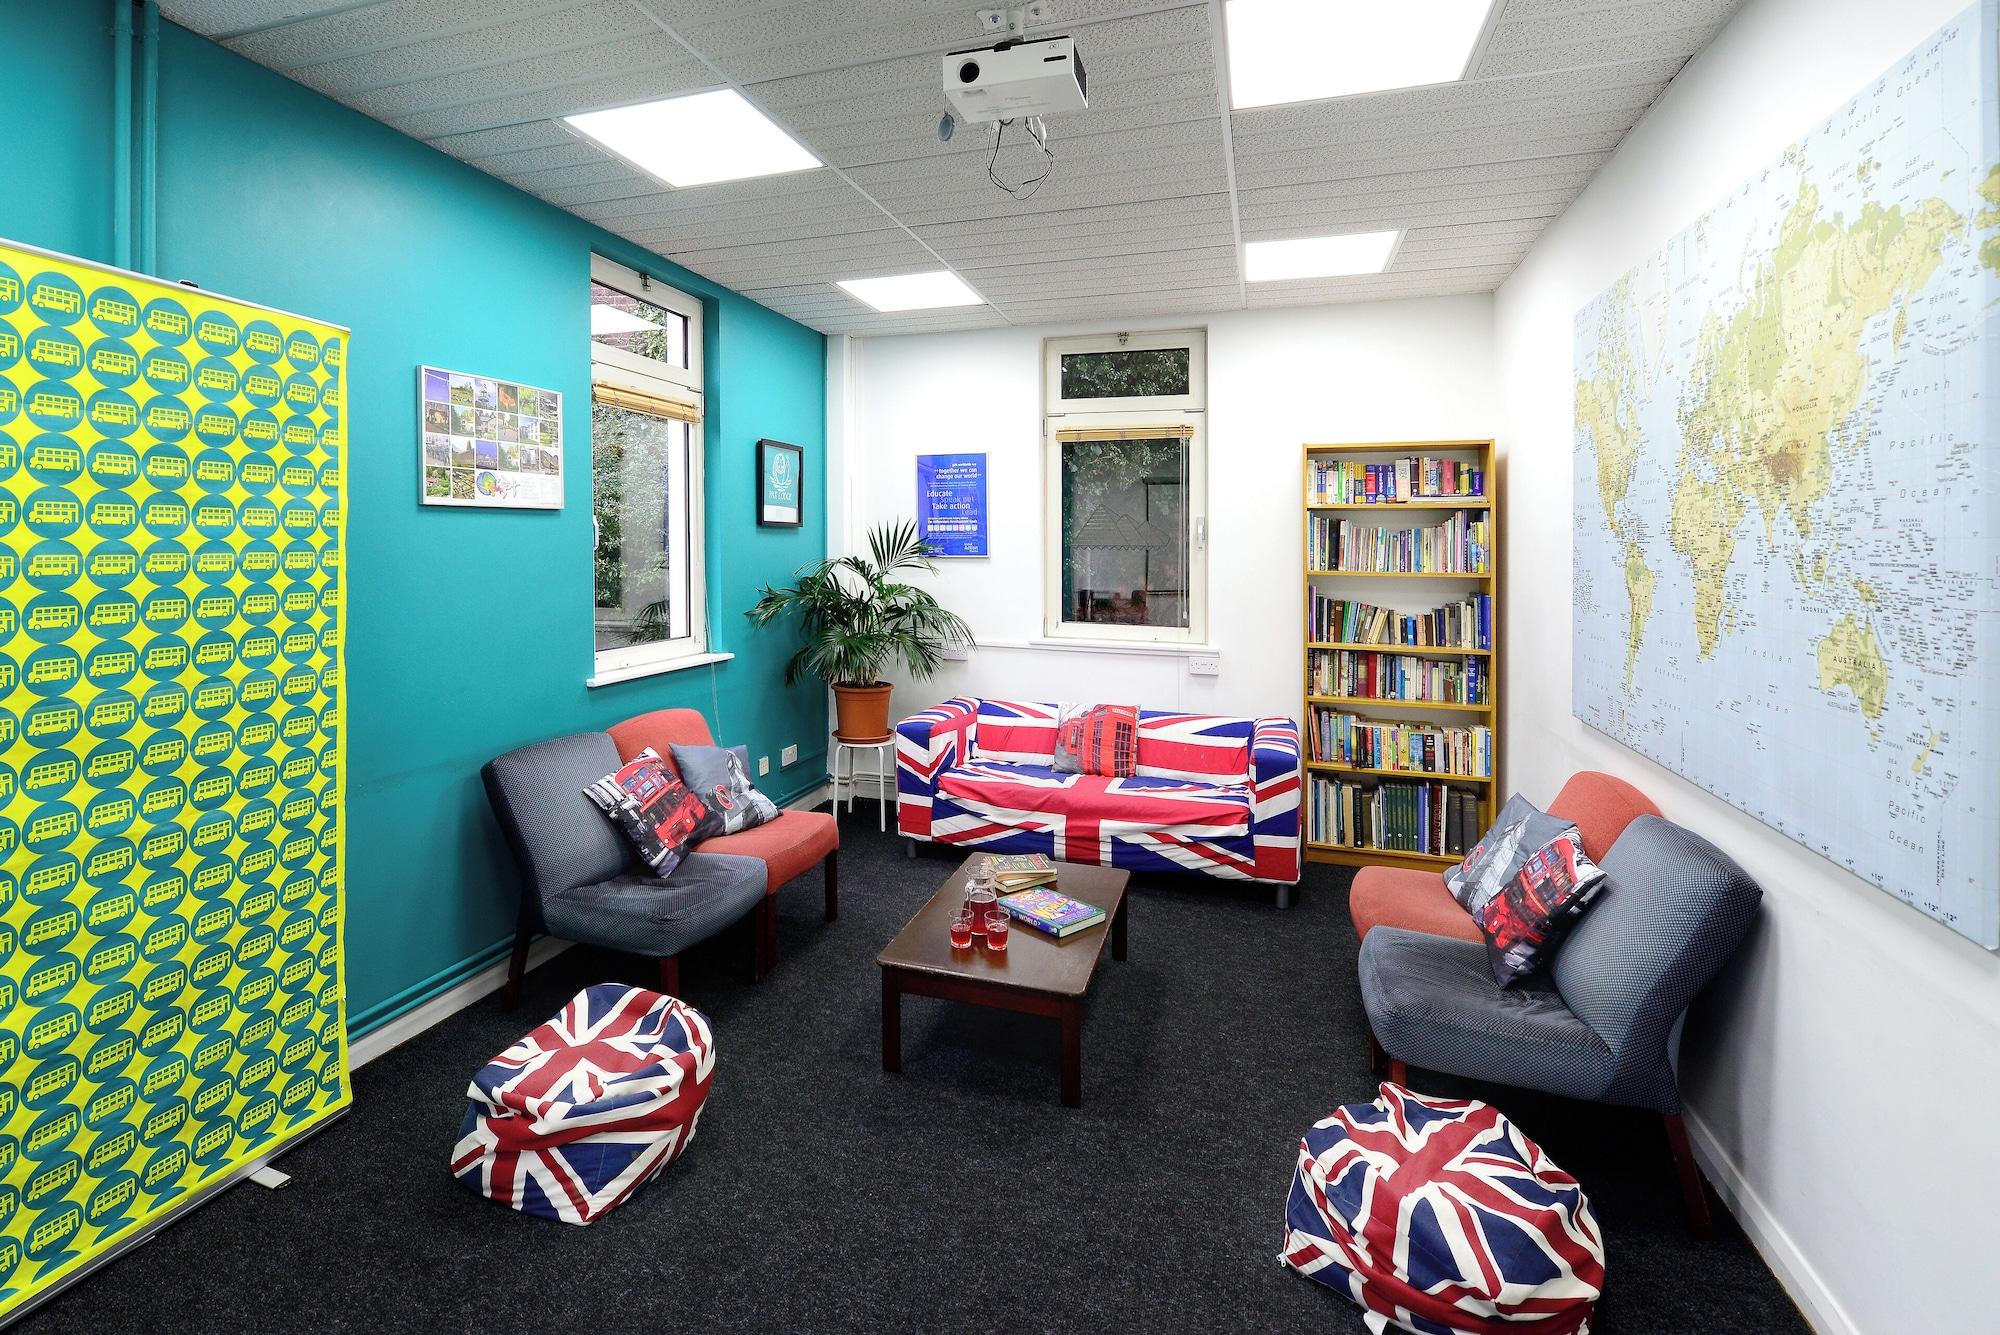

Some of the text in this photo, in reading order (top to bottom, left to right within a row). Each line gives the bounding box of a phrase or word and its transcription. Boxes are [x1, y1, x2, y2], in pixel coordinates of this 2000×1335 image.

[1900, 379, 1951, 400] North
[1889, 433, 1954, 451] Pacific
[926, 489, 953, 498] Educate
[1899, 487, 1952, 499] Ocean
[932, 502, 970, 510] Take action
[1832, 656, 1876, 670] AUSTRALIA
[1886, 770, 1930, 793] South
[1888, 799, 1927, 824] Pacific
[1888, 829, 1924, 854] Ocean
[1035, 897, 1068, 920] WORLD
